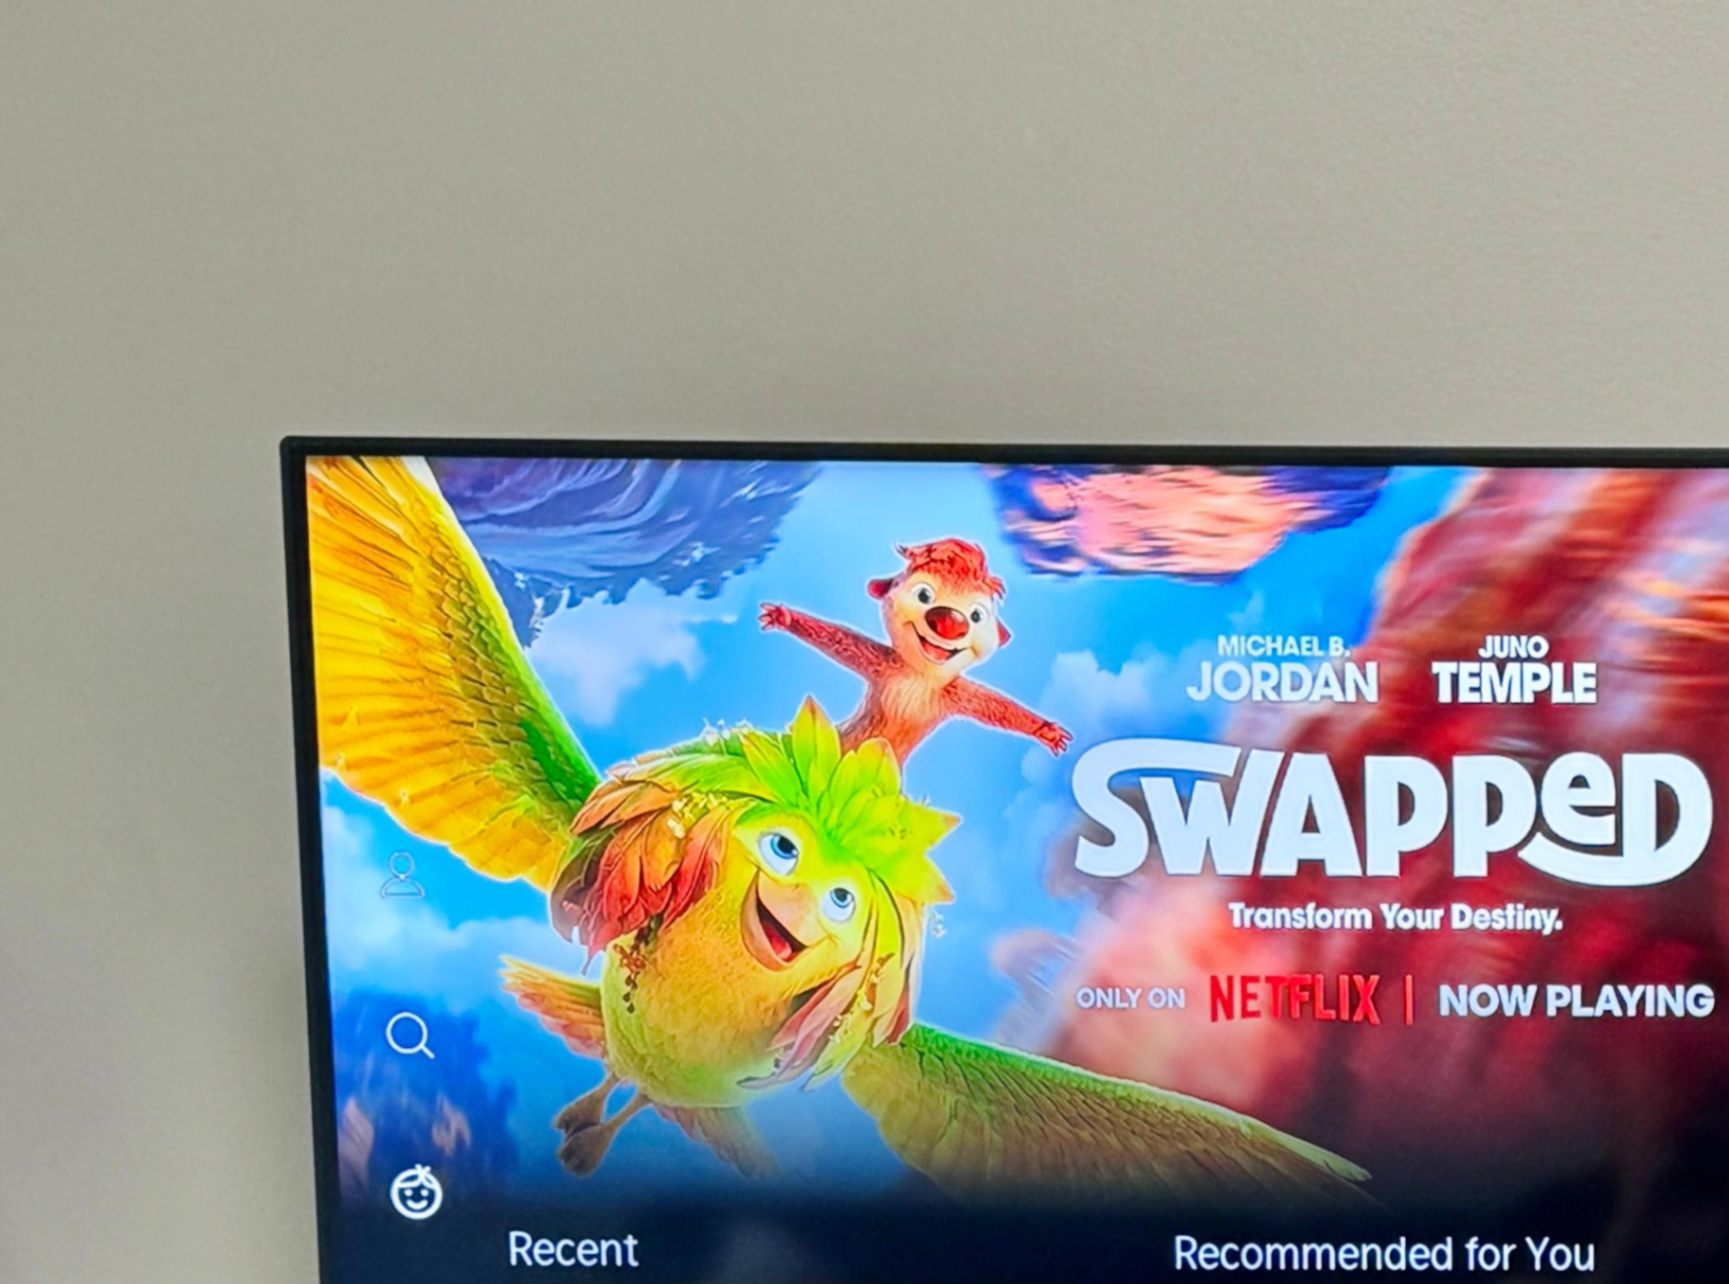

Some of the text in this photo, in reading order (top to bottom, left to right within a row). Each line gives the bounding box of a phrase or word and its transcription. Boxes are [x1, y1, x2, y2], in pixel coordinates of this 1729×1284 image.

[1218, 634, 1350, 658] MICHAEL B.
[1478, 635, 1549, 659] JUNO
[1187, 661, 1379, 703] JORDAN
[1432, 661, 1597, 704] TEMPLE
[1229, 902, 1563, 934] Transform Your Destiny.
[1076, 973, 1715, 1027] ONLY ON NETFLIX NOW PLAYING
[508, 1230, 640, 1268] Recent
[1174, 1234, 1596, 1272] Recommended for You
